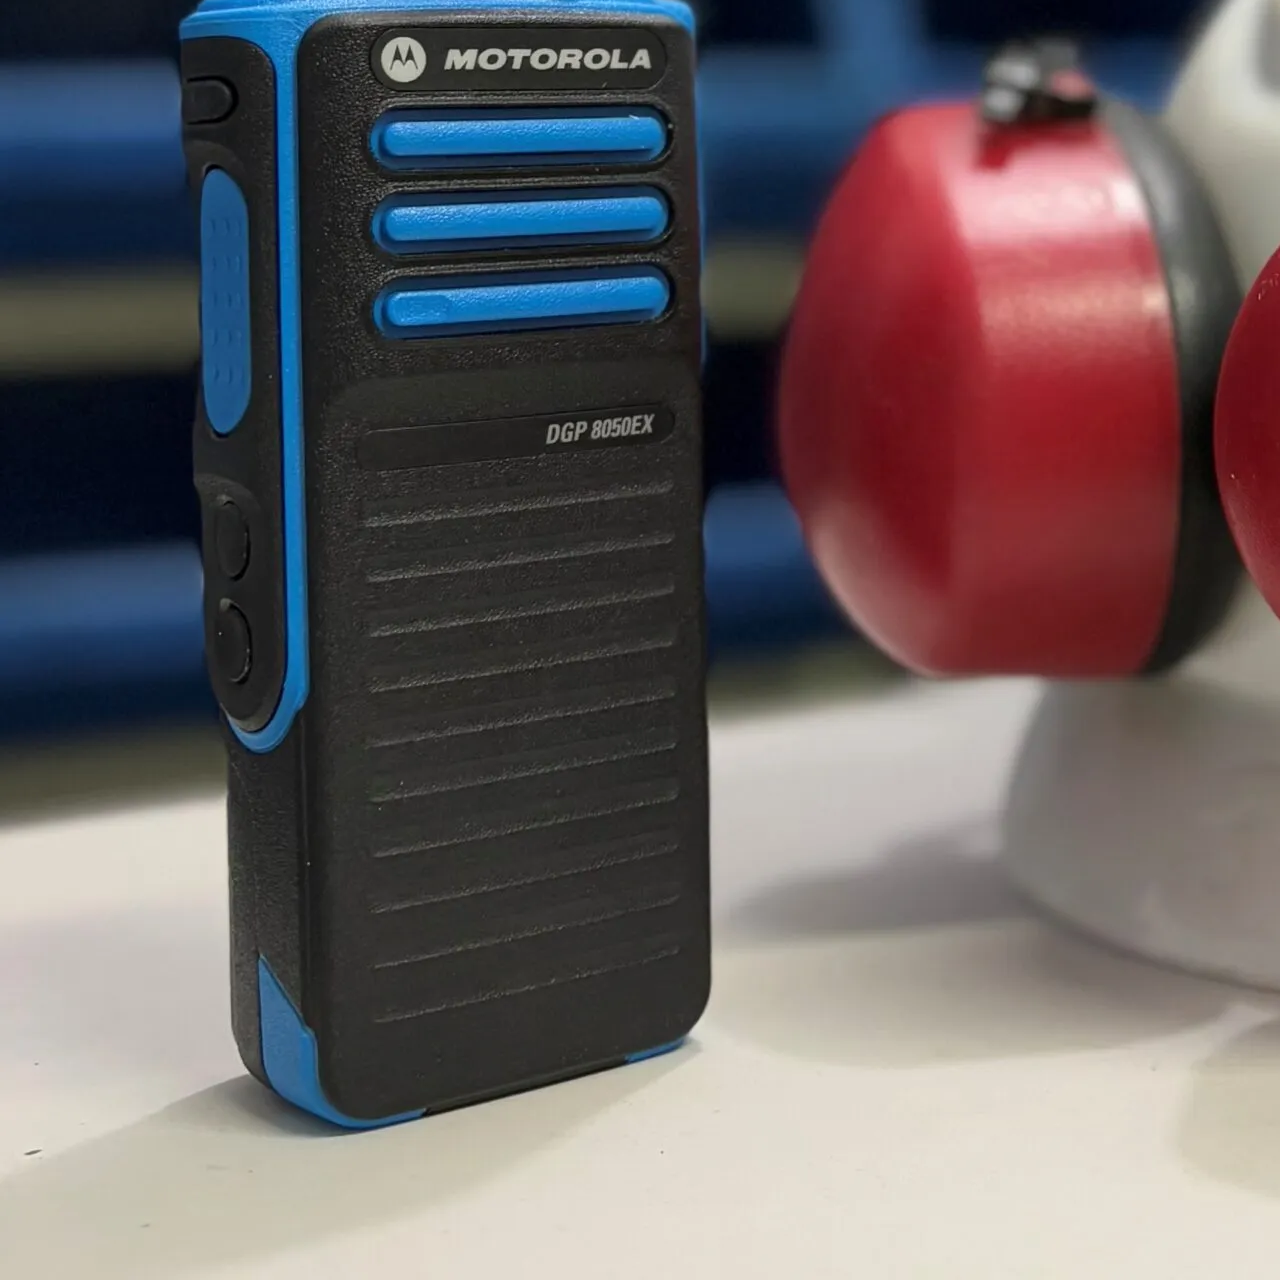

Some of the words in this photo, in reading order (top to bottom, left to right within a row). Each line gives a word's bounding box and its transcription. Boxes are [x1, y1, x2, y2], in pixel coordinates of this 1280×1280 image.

[443, 47, 652, 71] MOTOROLA
[545, 421, 588, 445] DGP
[590, 413, 656, 440] 8050EX
